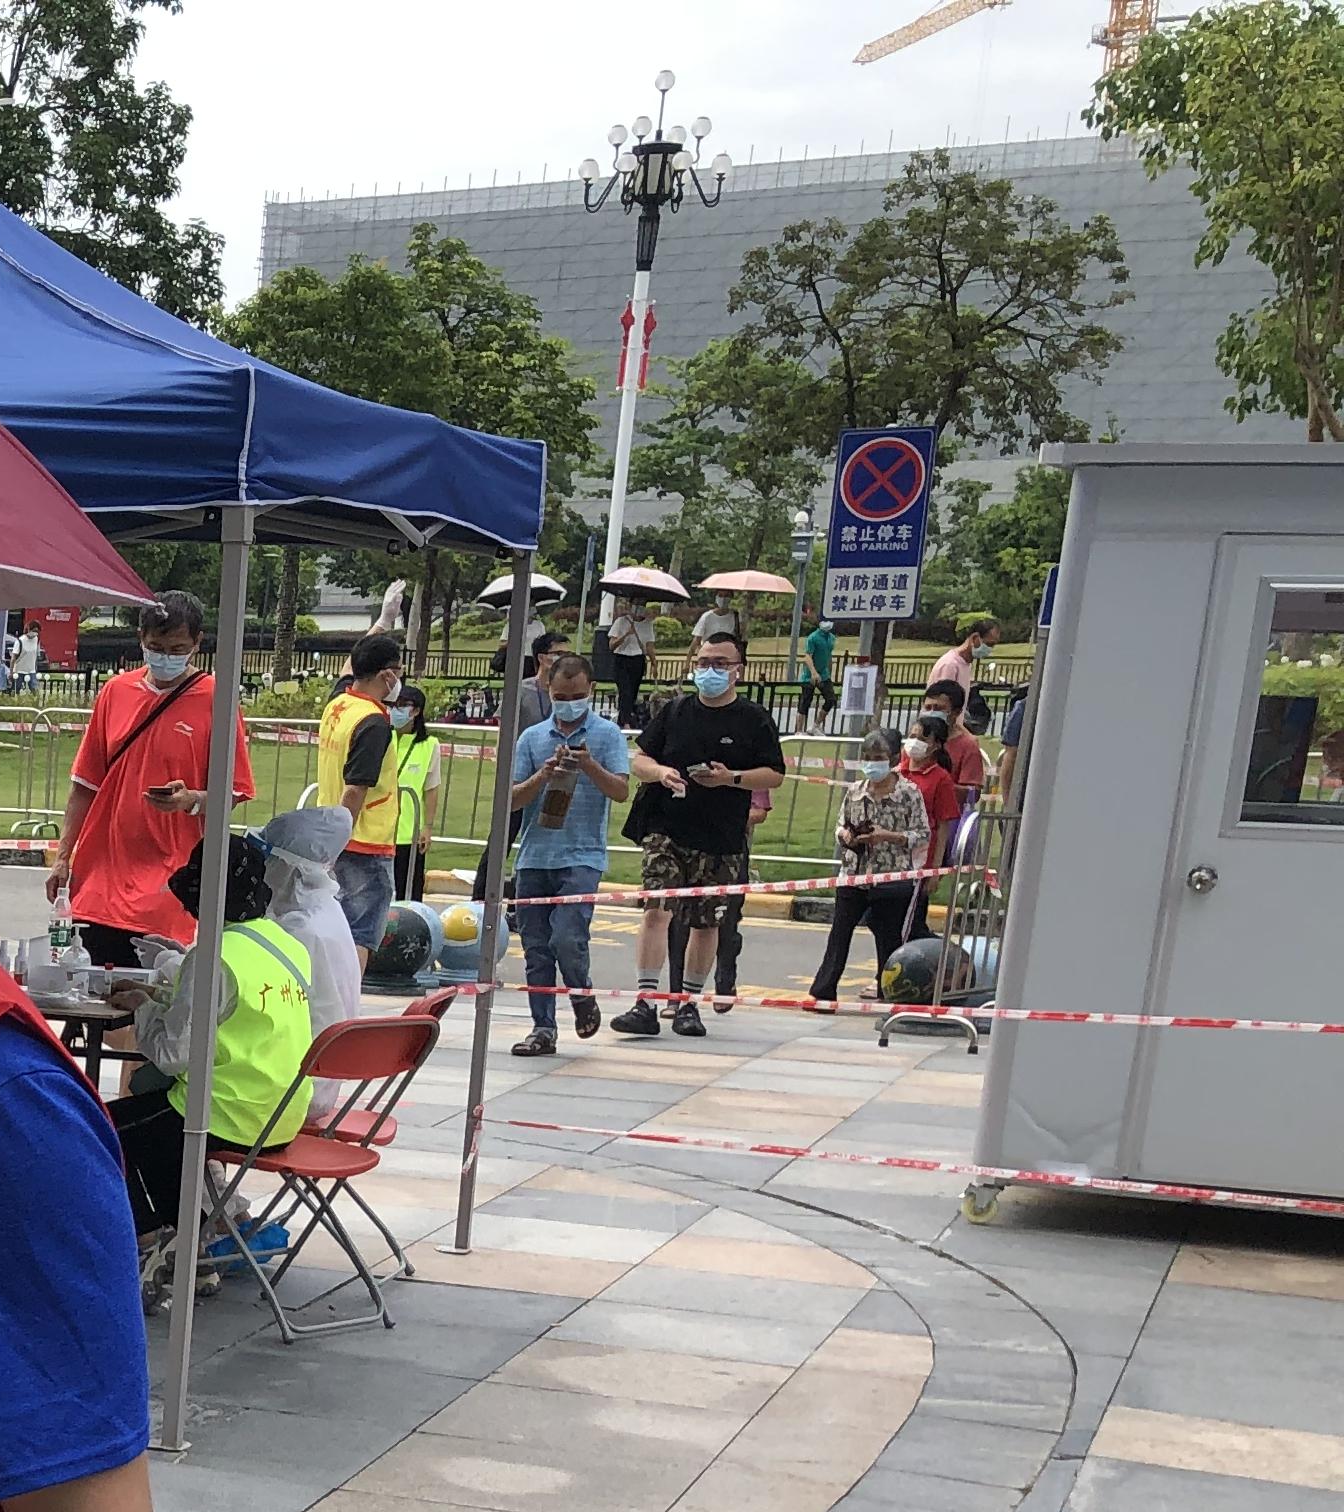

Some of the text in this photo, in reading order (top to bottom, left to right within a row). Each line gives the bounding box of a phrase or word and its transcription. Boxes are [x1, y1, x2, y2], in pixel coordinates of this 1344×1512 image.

[841, 524, 913, 542] 禁止停车
[841, 542, 909, 552] NO PARKING
[834, 574, 909, 591] 消防通道
[831, 595, 906, 612] 禁止停车
